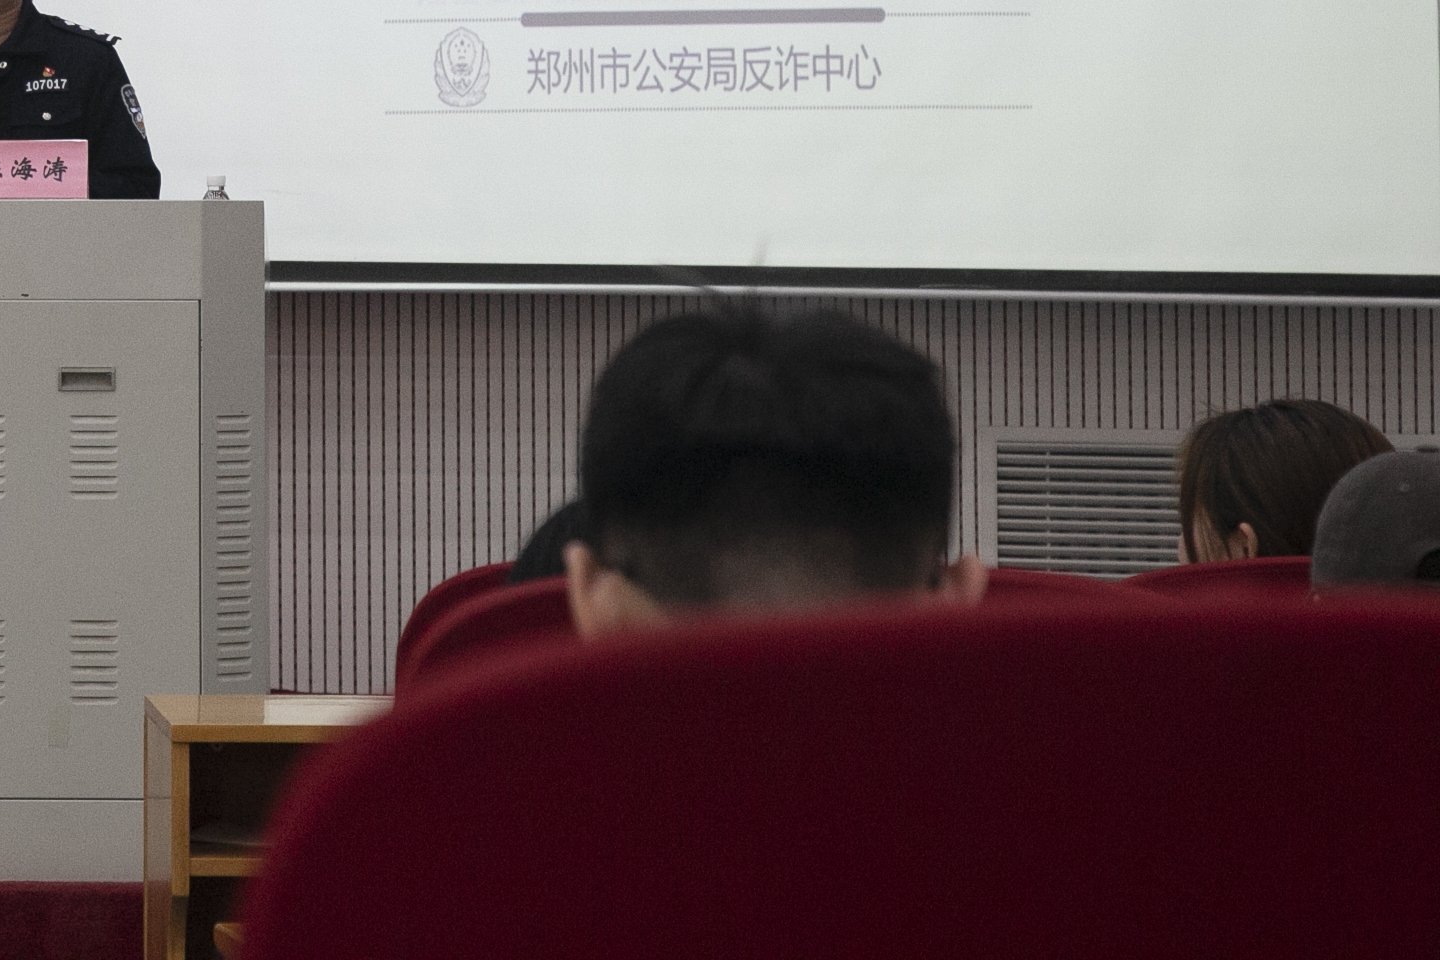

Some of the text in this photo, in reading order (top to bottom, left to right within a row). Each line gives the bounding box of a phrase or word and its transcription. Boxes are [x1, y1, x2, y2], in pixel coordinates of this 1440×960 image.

[25, 78, 68, 93] 107017
[526, 43, 882, 96] 郑州市公安局反诈中心
